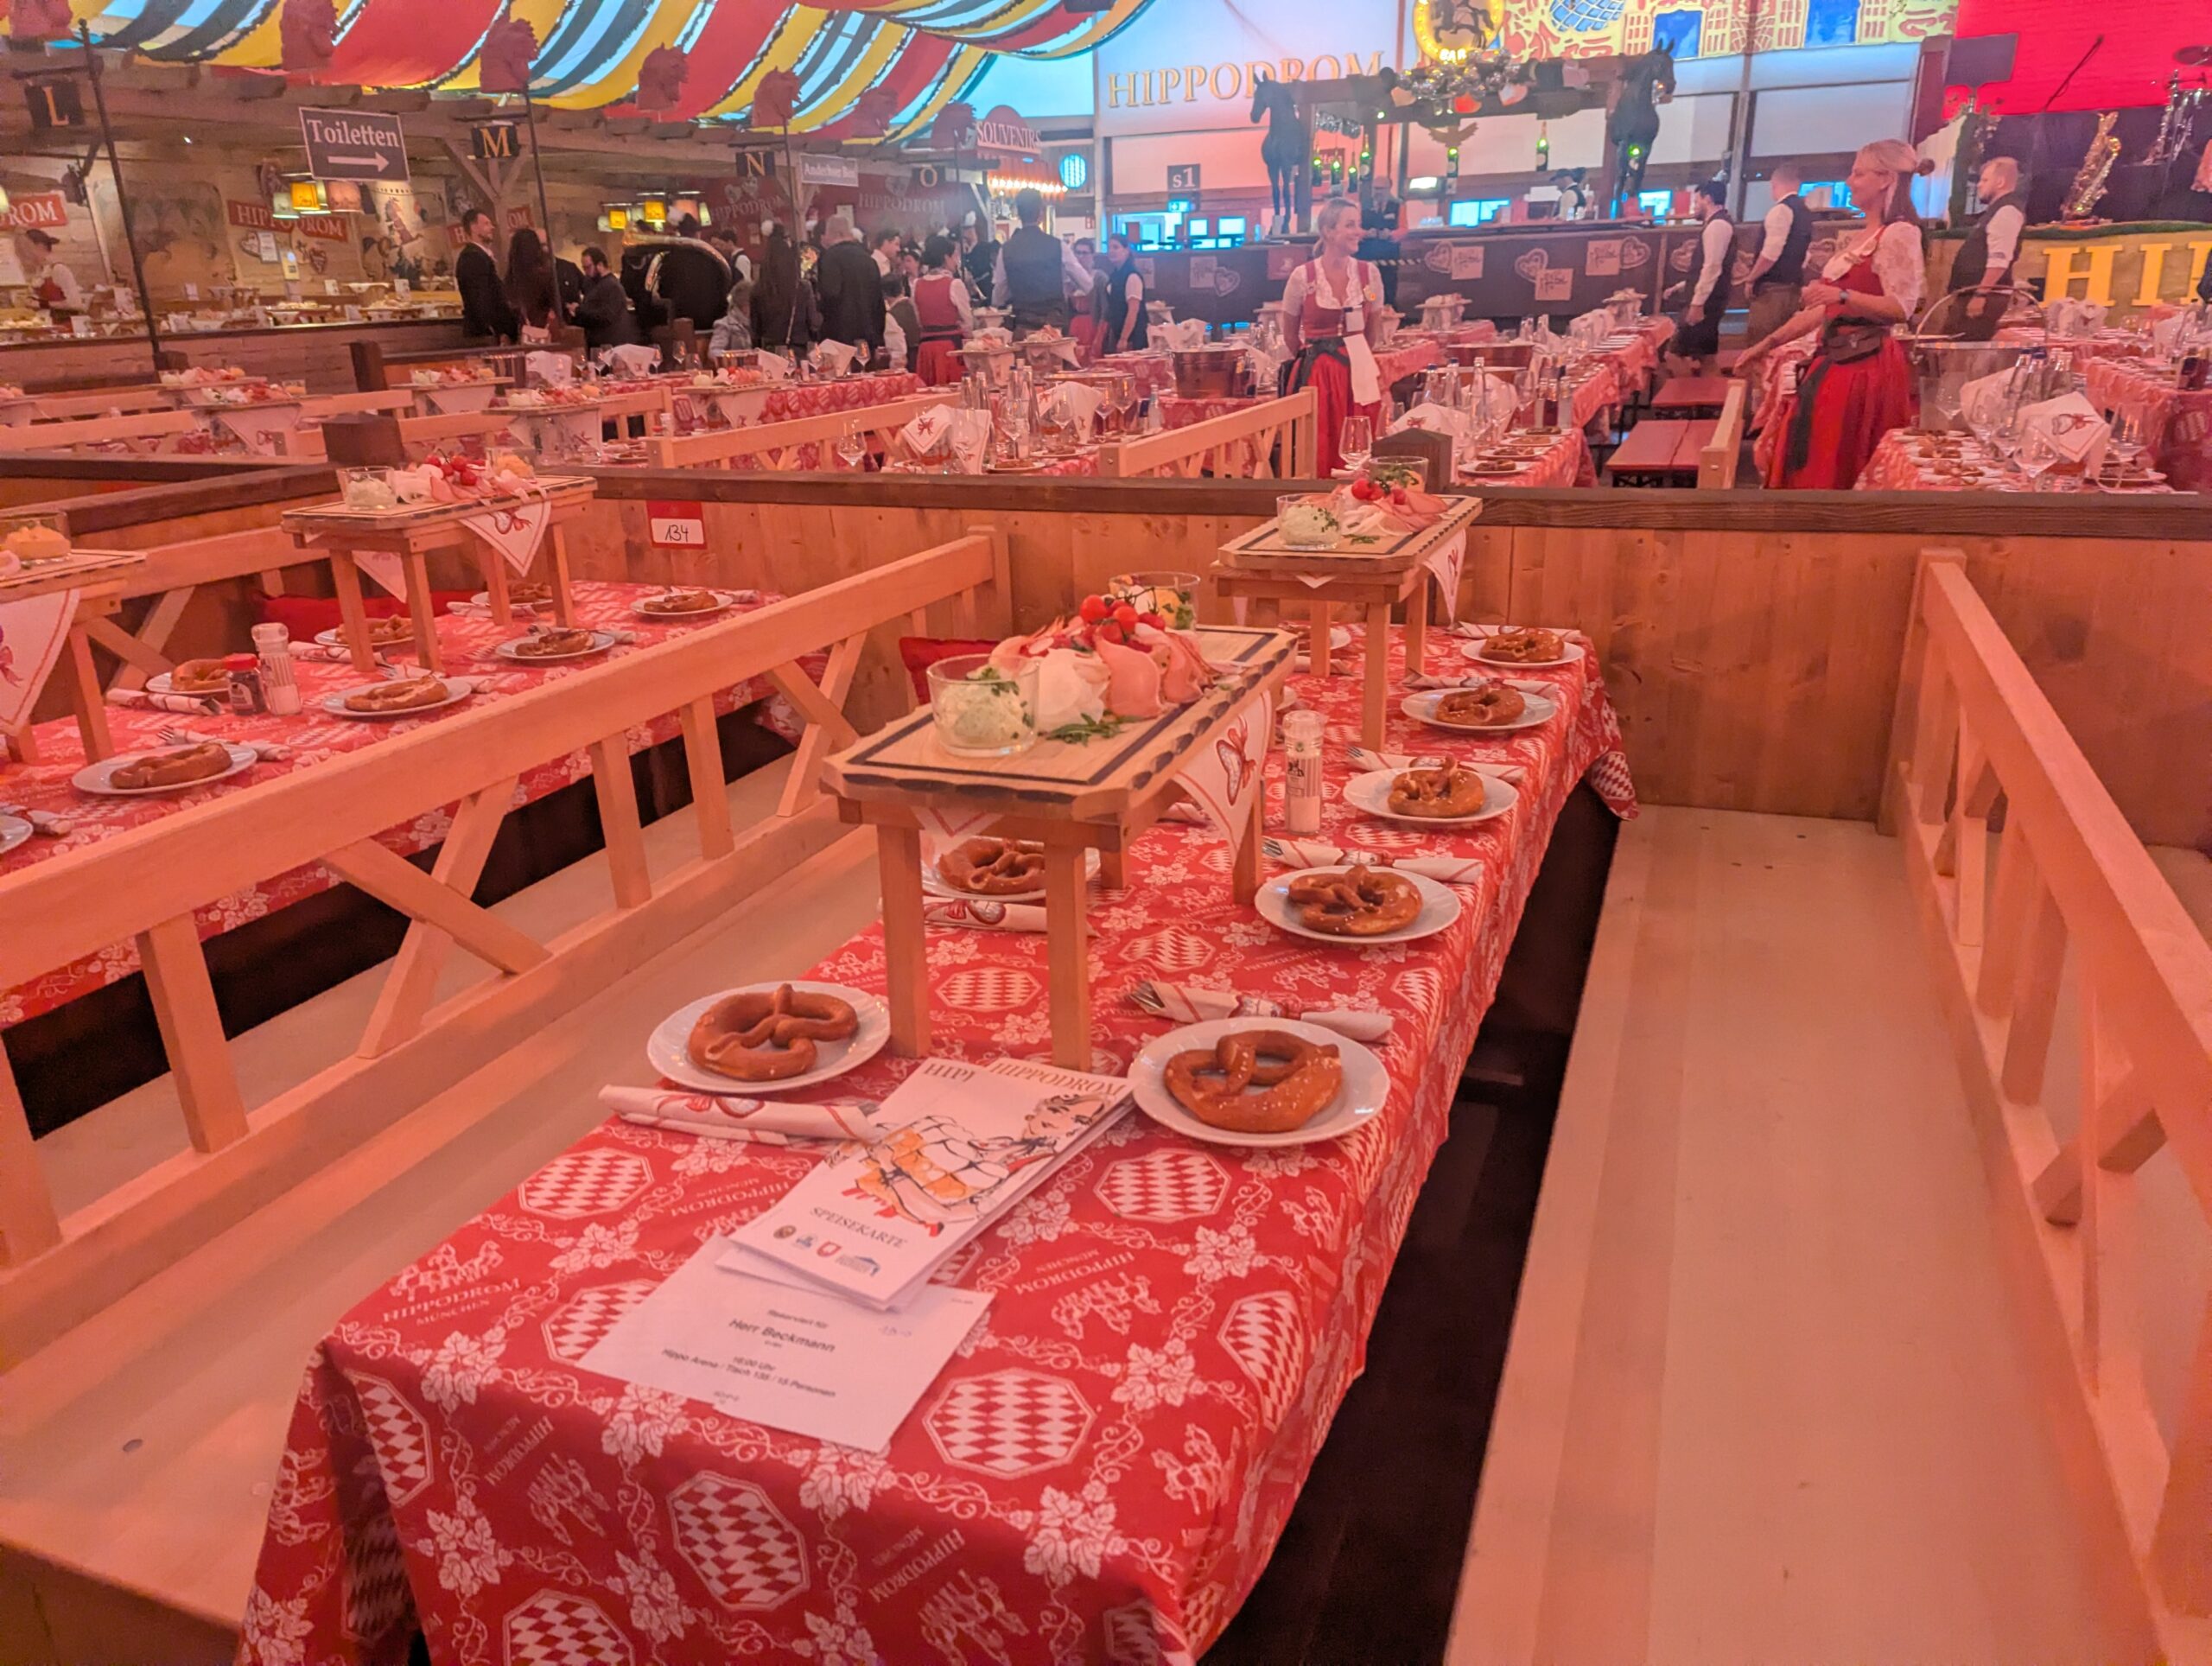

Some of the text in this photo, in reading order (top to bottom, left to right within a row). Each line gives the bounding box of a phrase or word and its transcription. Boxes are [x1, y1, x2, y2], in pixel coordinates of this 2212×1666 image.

[1439, 48, 1466, 61] BAR
[1107, 50, 1384, 108] HIPPODROM
[46, 87, 69, 127] L
[307, 119, 400, 148] Toiletten
[480, 128, 514, 158] M
[975, 121, 1042, 149] SOUVENIRS
[744, 151, 766, 176] N
[919, 166, 938, 188] O
[1172, 166, 1197, 188] s1
[664, 524, 690, 543] 134
[990, 1062, 1126, 1097] HIPPODROM
[670, 1181, 790, 1218] HIPPODROM
[809, 1206, 908, 1250] SPEISEKARTE
[1013, 1250, 1135, 1295] HIPPODROM
[382, 1278, 521, 1323] HIPPODROM
[728, 1318, 836, 1353] Herr Beckmann
[485, 1415, 556, 1487] HIPPODROM
[868, 1527, 966, 1604] HIPPODROM
